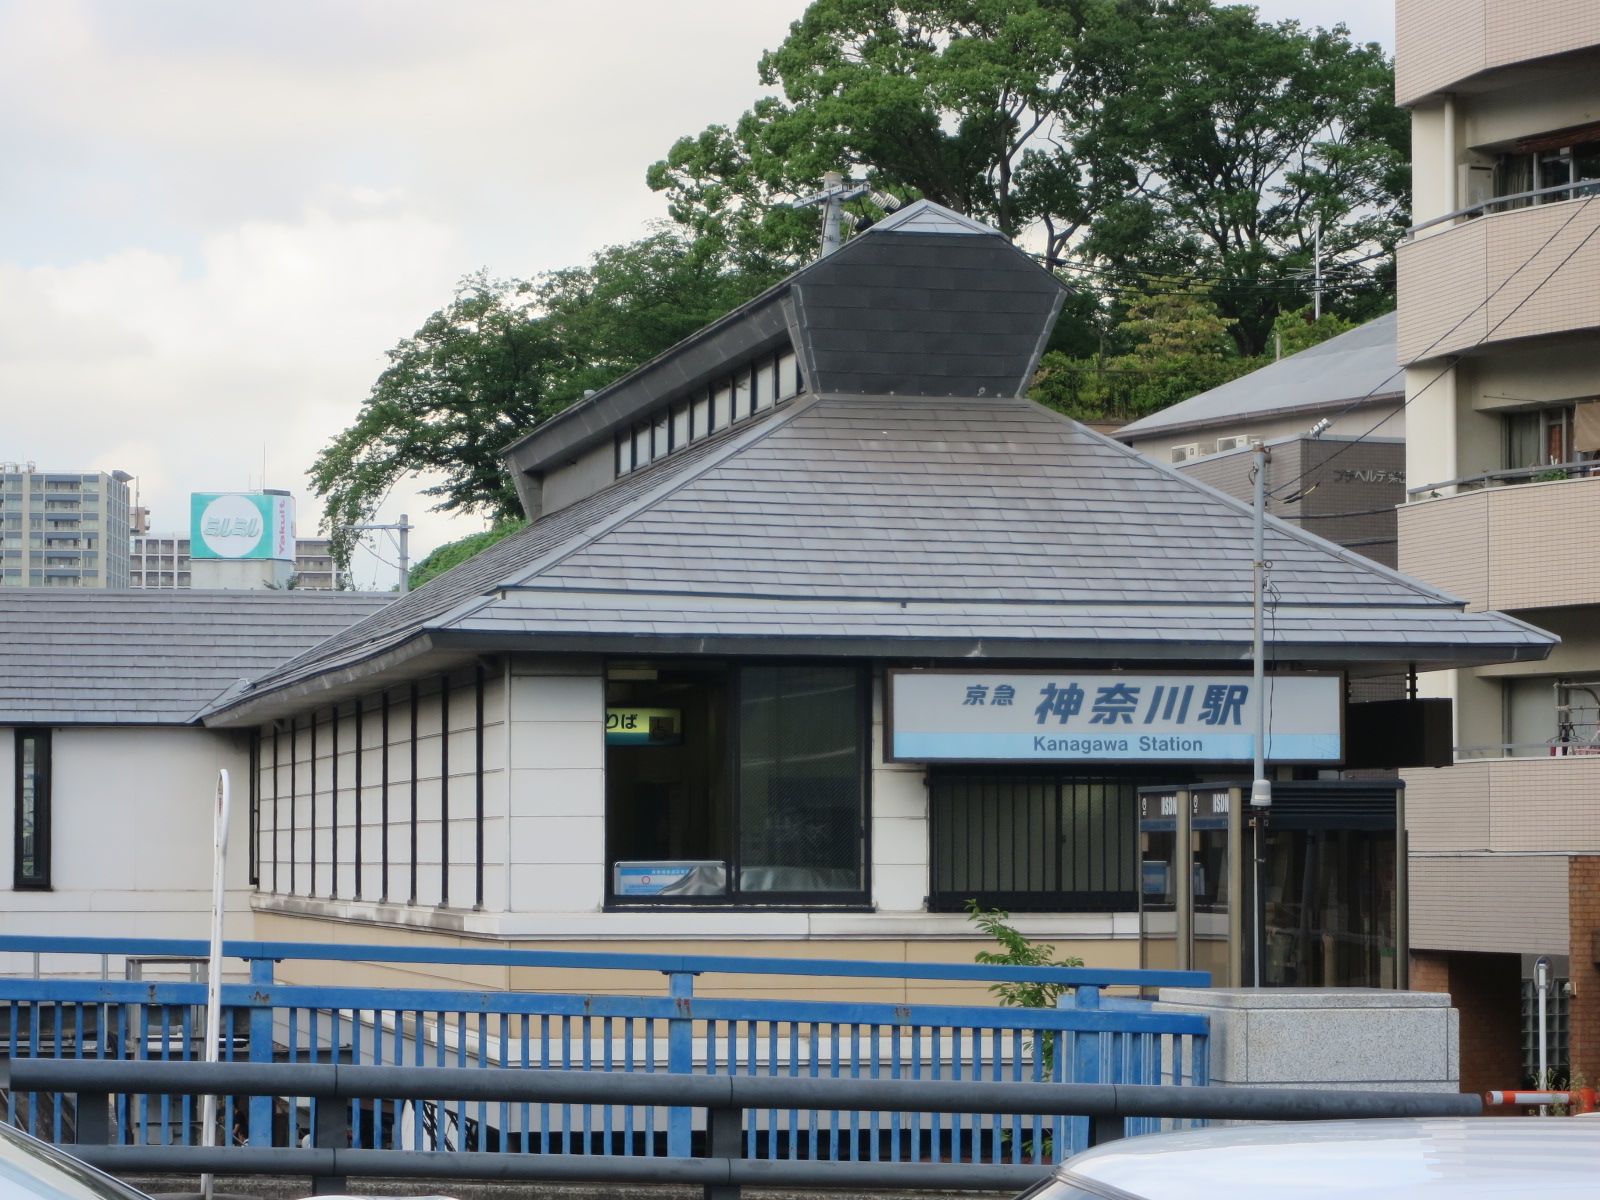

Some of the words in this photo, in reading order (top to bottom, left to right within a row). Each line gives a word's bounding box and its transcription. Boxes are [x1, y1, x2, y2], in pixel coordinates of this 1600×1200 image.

[203, 517, 259, 538] ミルミル
[278, 499, 286, 555] Yakult
[962, 684, 1016, 706] 京急
[1034, 682, 1249, 726] 神奈川駅
[1033, 735, 1129, 754] Kanagawa
[1138, 735, 1203, 752] Station
